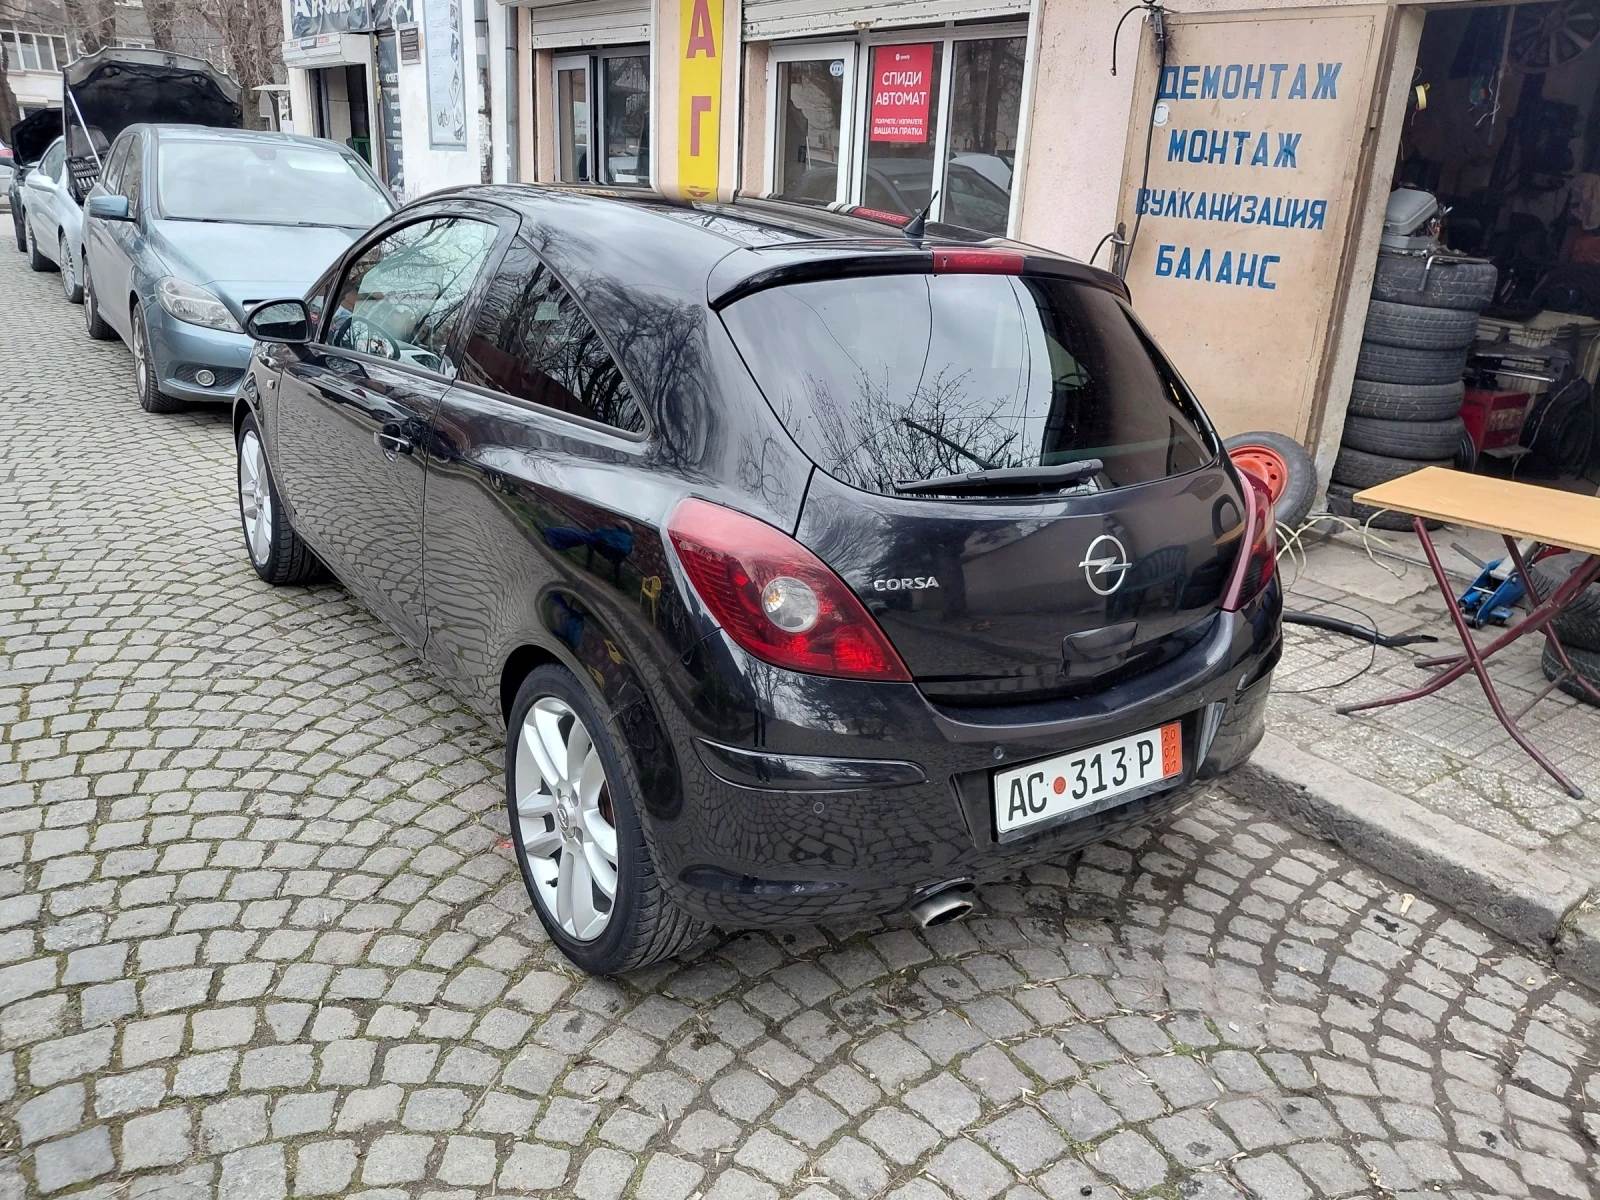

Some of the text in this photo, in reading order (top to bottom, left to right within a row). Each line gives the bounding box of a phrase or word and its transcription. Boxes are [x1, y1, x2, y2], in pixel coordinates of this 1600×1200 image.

[882, 71, 922, 87] СПИДИ
[1158, 62, 1342, 101] ДЕМОНТАЖ
[875, 91, 926, 105] АВТОМАТ
[874, 126, 923, 136] ВАШАТА ПРАТКА
[1167, 129, 1302, 168] МОНТАЖ
[1136, 188, 1327, 230] ВУЛКАНИЗАЦИЯ
[1155, 244, 1281, 289] БАЛАНС
[873, 576, 940, 591] CORSA
